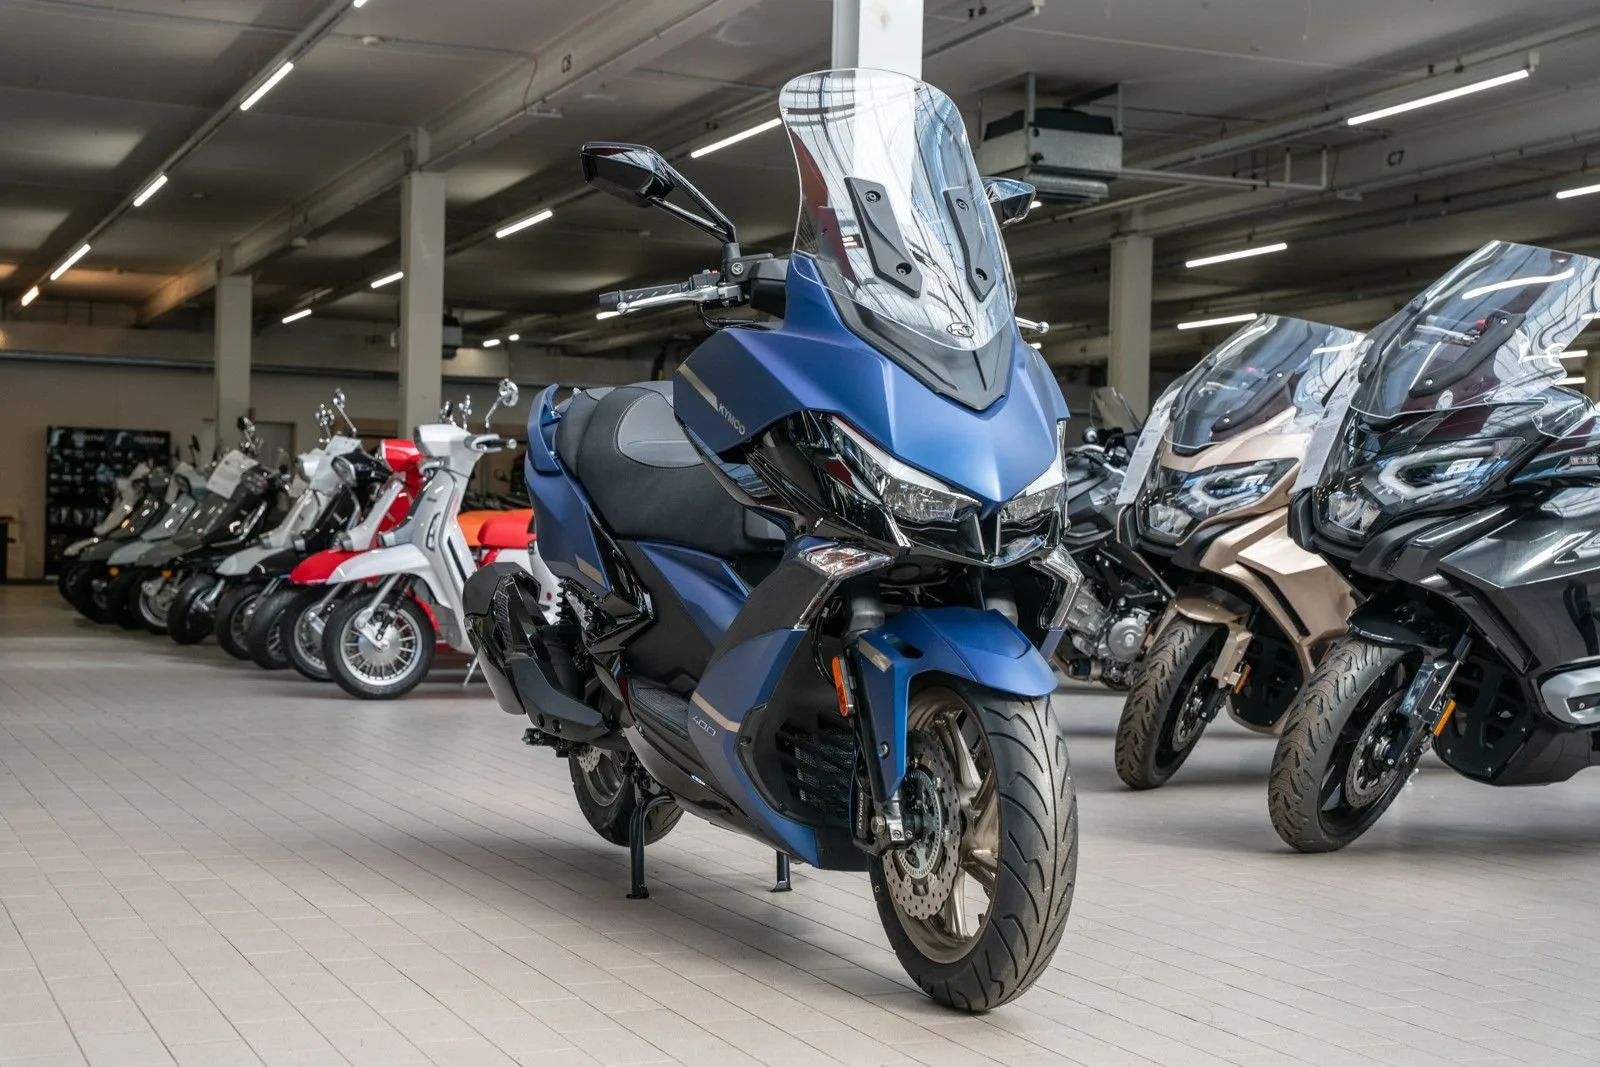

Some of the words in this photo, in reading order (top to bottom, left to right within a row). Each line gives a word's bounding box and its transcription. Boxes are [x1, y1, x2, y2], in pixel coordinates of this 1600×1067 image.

[1387, 150, 1405, 167] C7
[718, 403, 746, 435] KYMCO
[692, 715, 717, 737] 400
